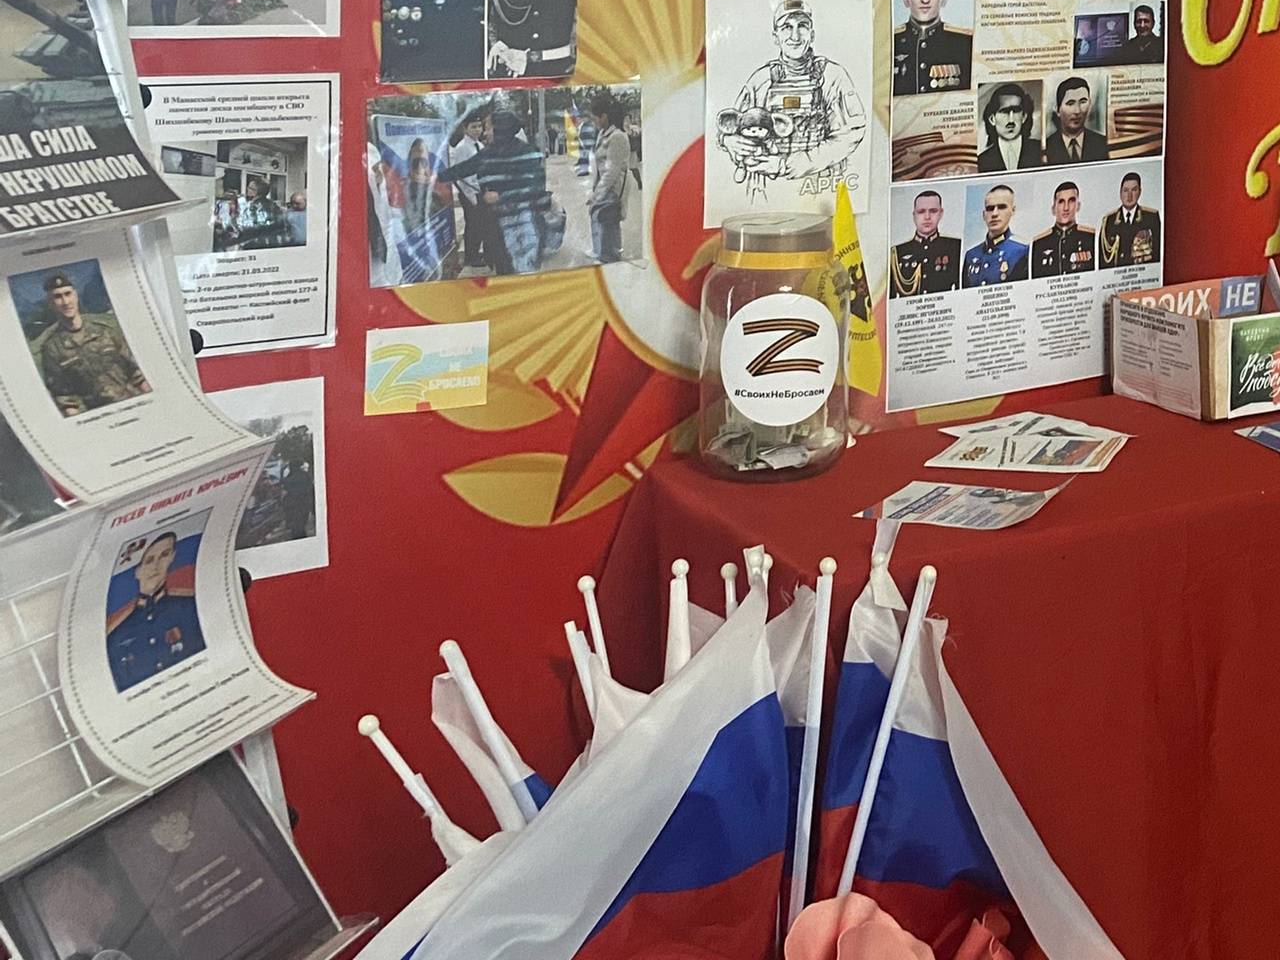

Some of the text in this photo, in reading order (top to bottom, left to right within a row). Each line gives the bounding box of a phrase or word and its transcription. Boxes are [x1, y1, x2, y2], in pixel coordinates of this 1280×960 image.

[29, 125, 97, 157] СИЛА
[0, 153, 148, 197] НЕРУШИМОМ
[0, 191, 122, 229] БРАТСТВЕ
[1226, 277, 1256, 309] НЕ
[735, 388, 825, 399] #СвоихНеБросаем
[110, 507, 146, 529] ГУСЕВ
[149, 489, 194, 513] НИКИТА
[196, 467, 249, 494] ЮРЬЕВИЧ
